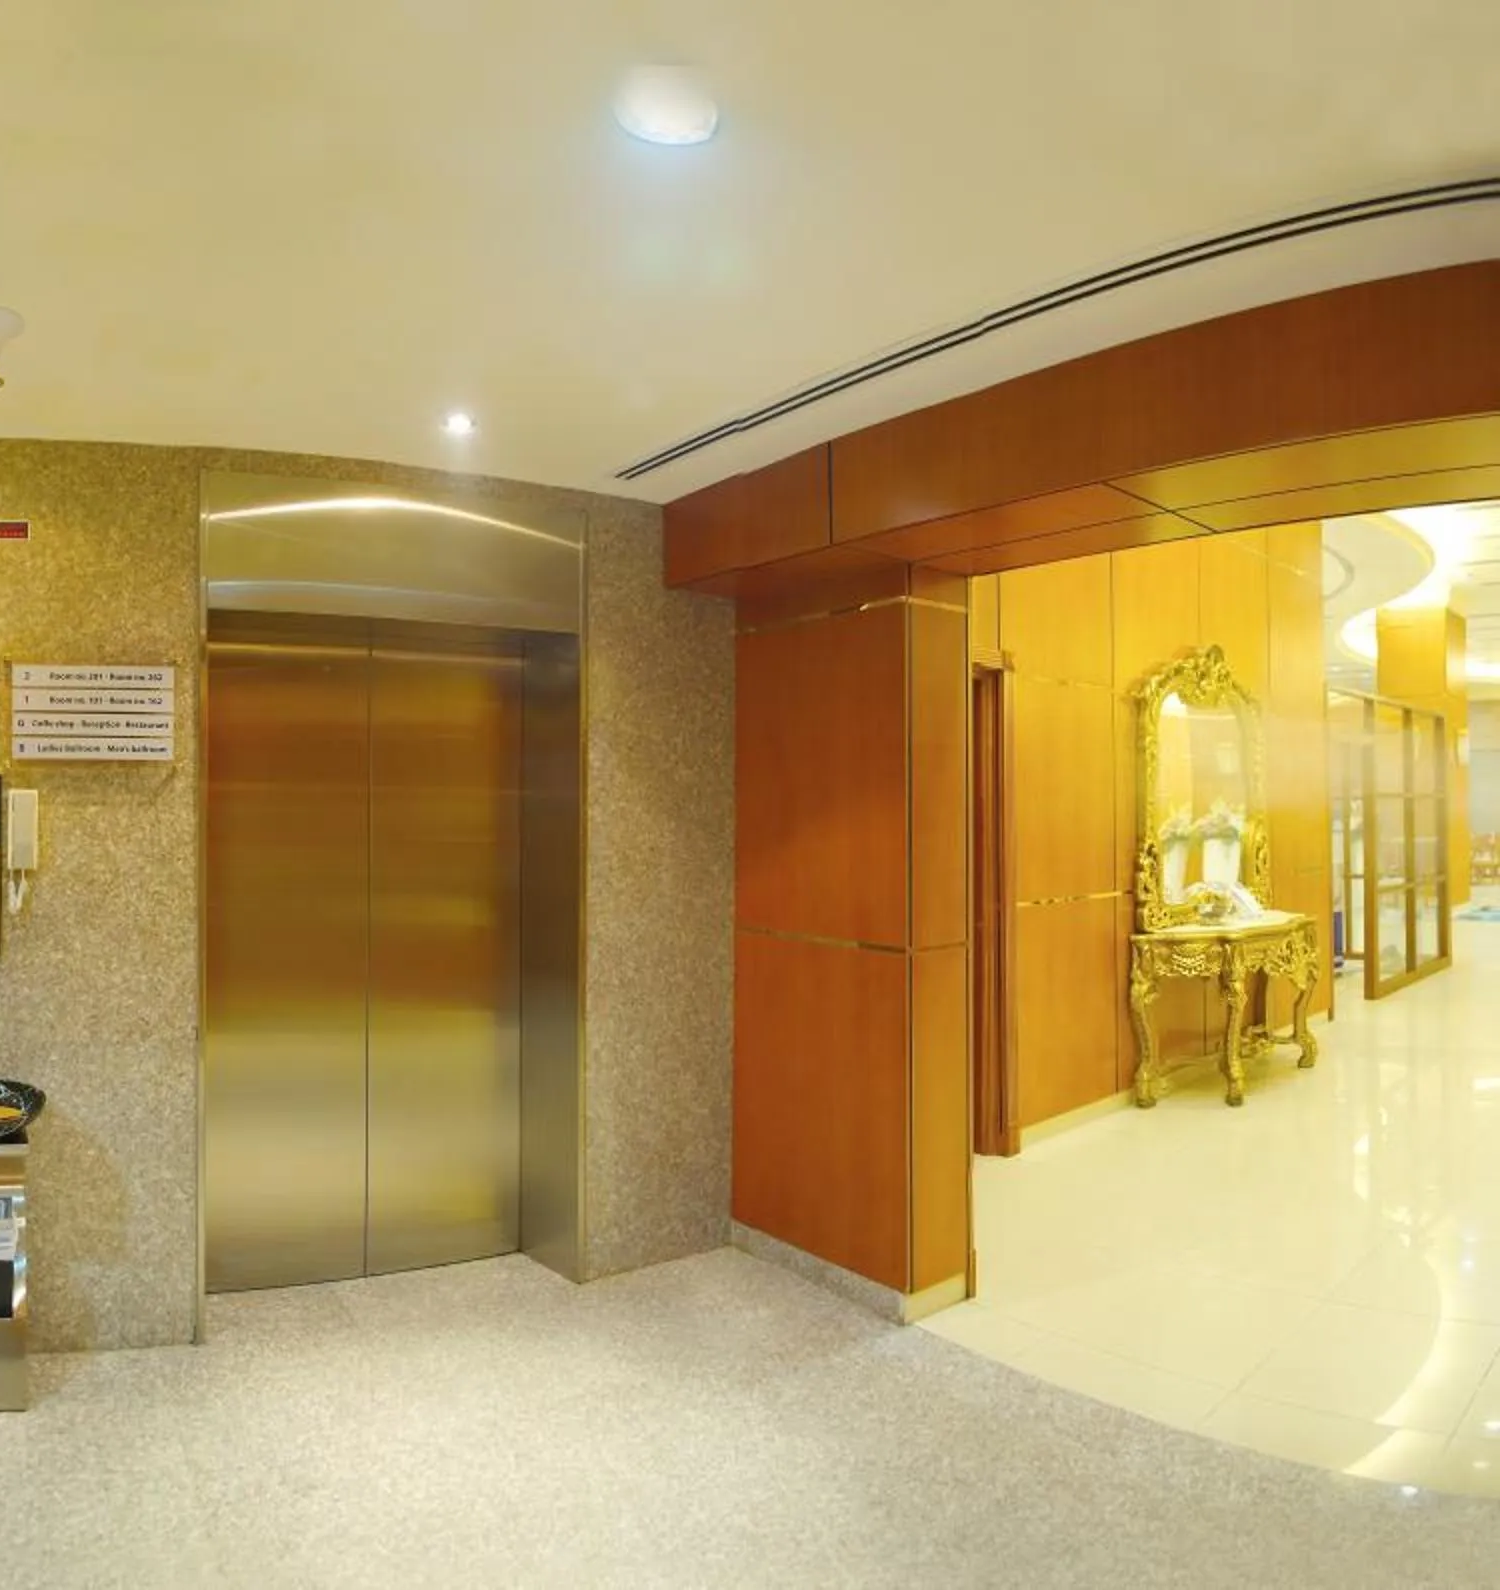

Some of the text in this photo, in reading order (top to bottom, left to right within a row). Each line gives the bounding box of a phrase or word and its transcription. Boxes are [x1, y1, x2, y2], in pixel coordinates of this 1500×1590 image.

[49, 672, 72, 681] Room
[109, 672, 132, 681] Room
[49, 695, 72, 704] Room
[109, 695, 132, 704] Room
[81, 719, 121, 730] Reception
[125, 720, 169, 729] Restaurant
